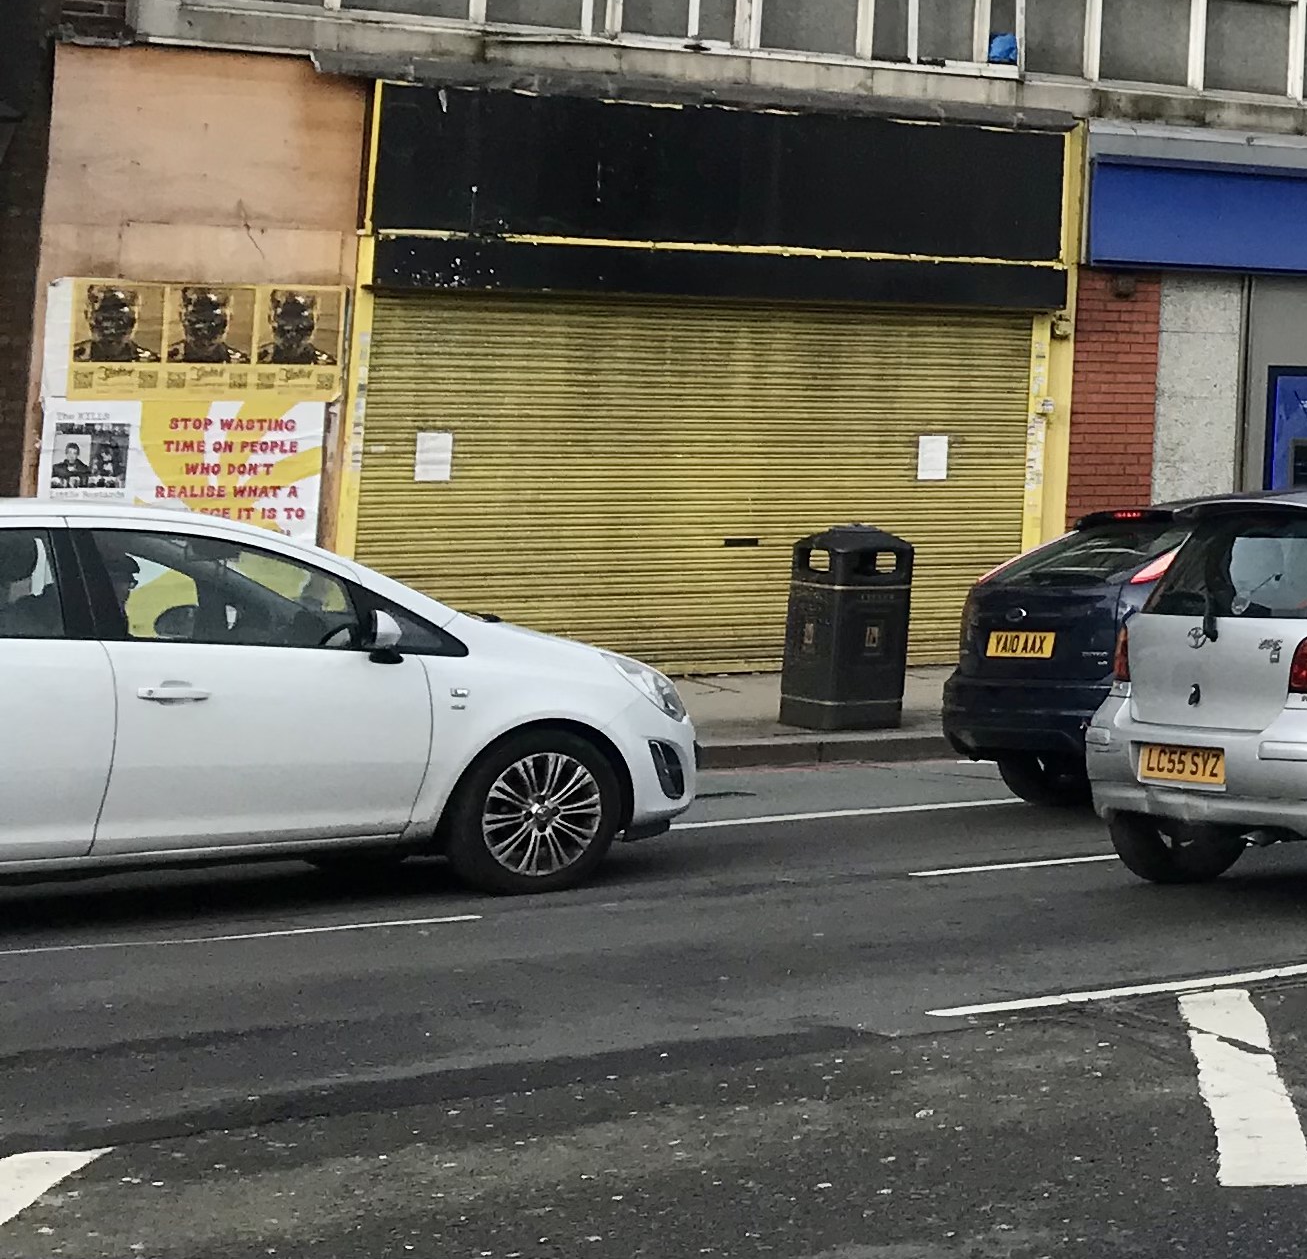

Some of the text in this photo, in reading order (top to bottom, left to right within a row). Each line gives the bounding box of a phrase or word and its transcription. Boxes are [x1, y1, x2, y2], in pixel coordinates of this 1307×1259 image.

[168, 417, 297, 432] STOP WASTING
[164, 440, 298, 453] TIME ON PEOPLE
[184, 463, 274, 476] WHO DON'T
[155, 485, 298, 498] REALISE WHAT A
[237, 507, 255, 520] IT
[261, 507, 277, 520] IS
[283, 507, 305, 520] TO
[1019, 635, 1048, 655] AAX
[1146, 746, 1221, 777] LC55 SYZ
